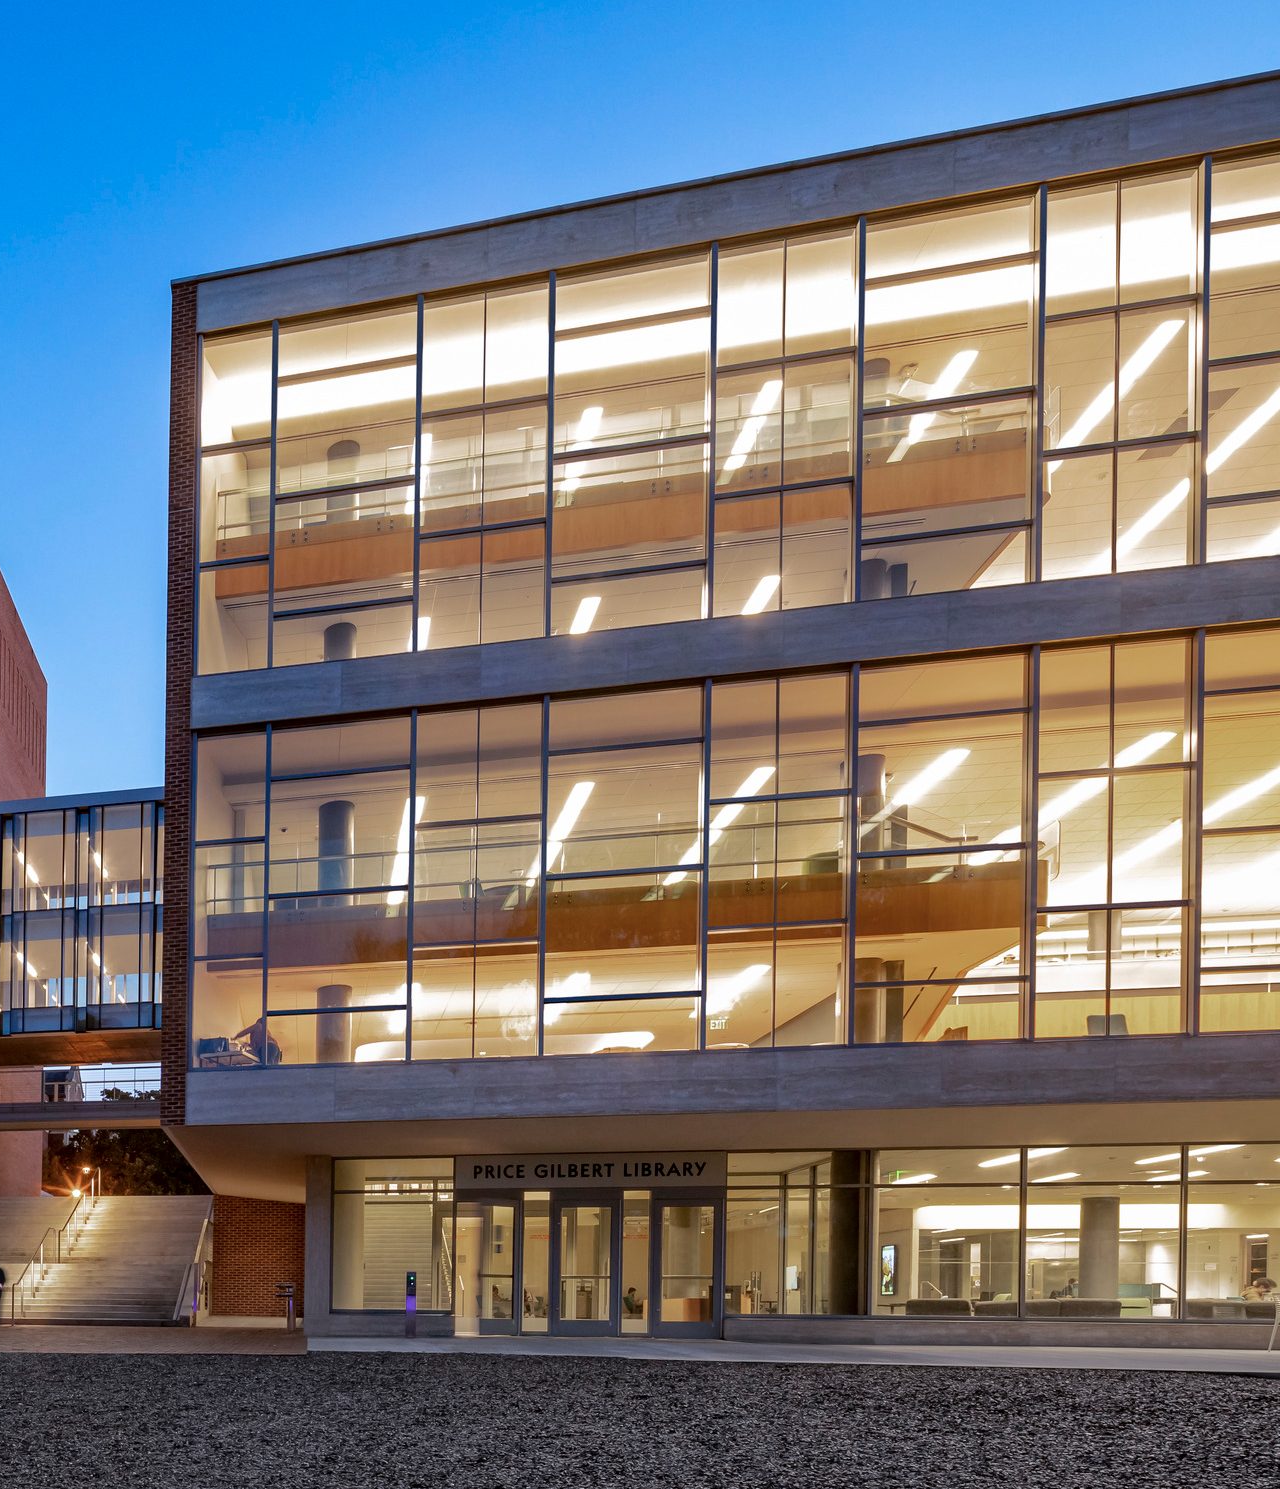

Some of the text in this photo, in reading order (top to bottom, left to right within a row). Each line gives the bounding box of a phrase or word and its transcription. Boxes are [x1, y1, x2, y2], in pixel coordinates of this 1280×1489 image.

[710, 1019, 726, 1030] EXIT
[473, 1161, 707, 1179] PRICE GILBERT LIBRARY
